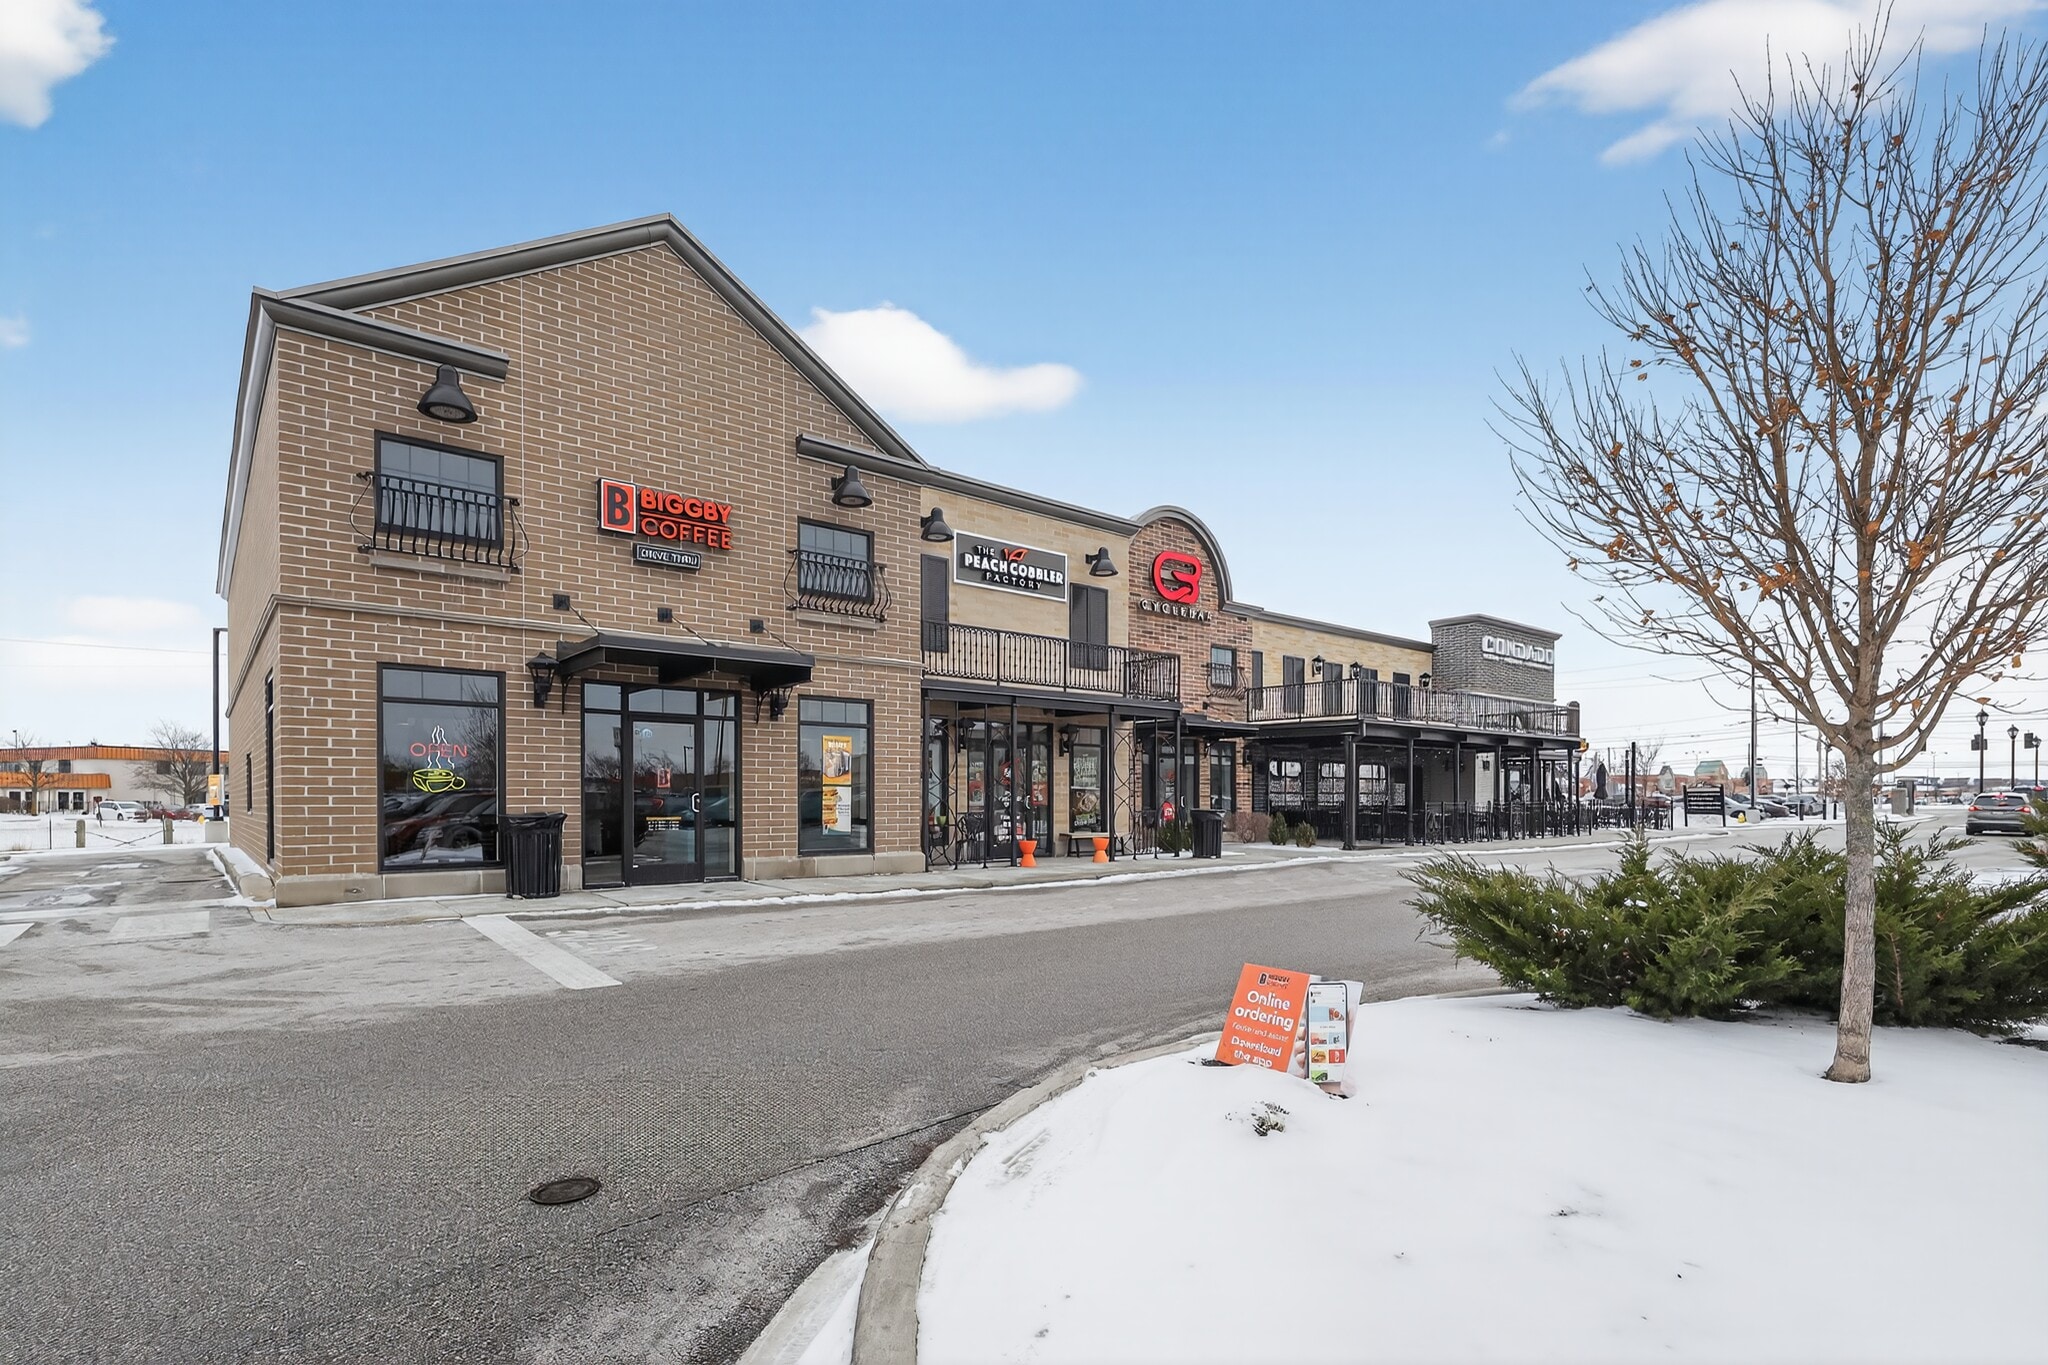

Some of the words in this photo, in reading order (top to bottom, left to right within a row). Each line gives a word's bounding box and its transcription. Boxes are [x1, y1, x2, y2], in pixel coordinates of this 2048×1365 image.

[606, 484, 631, 527] B
[639, 487, 733, 524] BIGGBY
[640, 517, 734, 551] COFFEE
[975, 545, 996, 556] THE
[963, 553, 1008, 574] PEACH
[1009, 562, 1064, 585] COBBLER
[985, 572, 1042, 590] FACTORY
[1482, 635, 1554, 665] CONDADO
[410, 742, 469, 758] OPEN
[1247, 990, 1291, 1010] Online
[1234, 1006, 1294, 1031] ordering
